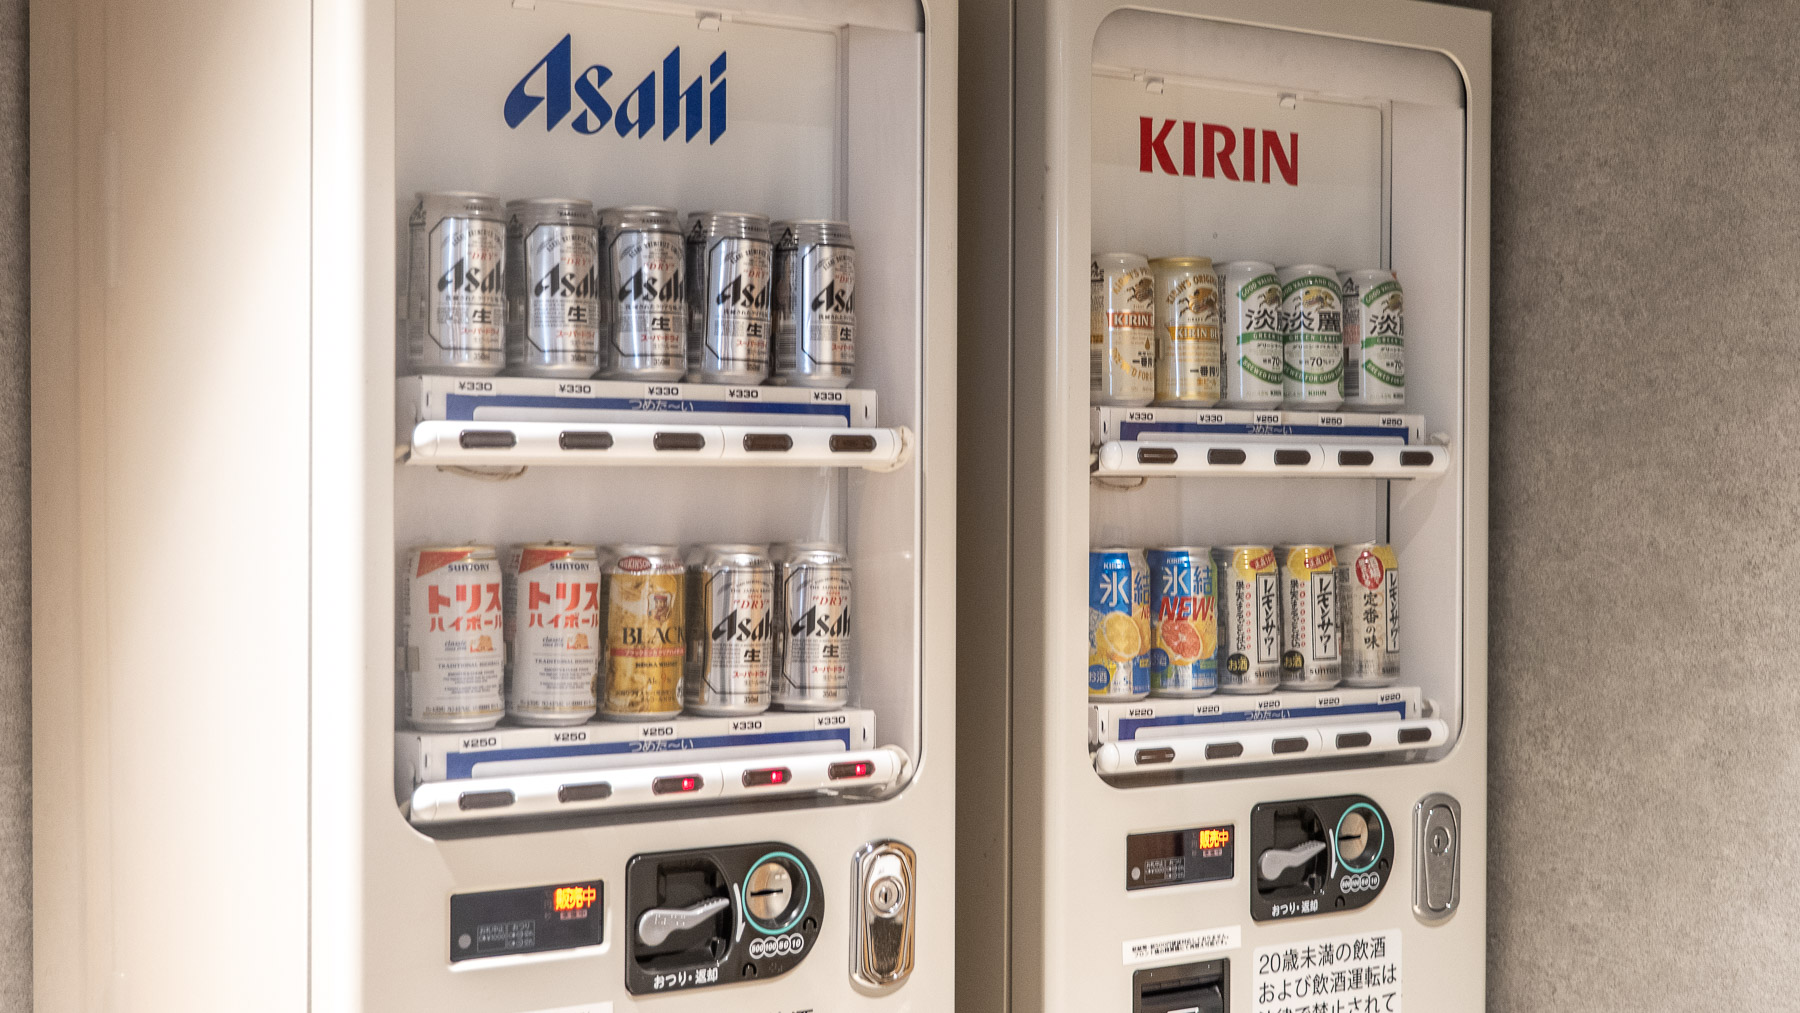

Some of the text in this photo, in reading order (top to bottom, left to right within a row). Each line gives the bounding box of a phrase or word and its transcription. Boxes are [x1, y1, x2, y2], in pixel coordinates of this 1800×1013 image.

[504, 33, 727, 146] Asahi
[1140, 115, 1299, 187] KIRIN
[1314, 279, 1326, 287] AND
[472, 308, 492, 324] 生
[568, 305, 588, 323] 生
[1114, 314, 1150, 327] KIRIN
[652, 317, 671, 331] 生
[747, 323, 763, 338] 生
[1370, 313, 1404, 336] 淡
[840, 327, 852, 341] 生
[1178, 327, 1207, 338] KIRIN
[459, 382, 493, 391] ¥330
[559, 385, 591, 394] ¥330
[647, 387, 679, 396] ¥330
[728, 389, 759, 399] ¥330
[813, 392, 842, 401] ¥330
[1129, 412, 1154, 421] ¥330
[1199, 414, 1223, 422] ¥330
[1256, 415, 1279, 423] ¥250
[1320, 417, 1342, 425] ¥250
[1381, 418, 1402, 426] ¥250
[448, 562, 490, 573] SUNTORY
[549, 562, 590, 572] SUNTORY
[1163, 565, 1213, 597] 氷結
[528, 581, 599, 611] トリス
[1100, 571, 1150, 607] 氷結
[428, 582, 502, 615] トリス
[1158, 596, 1216, 621] NEW!
[1389, 571, 1400, 650] レモンサワー
[429, 614, 503, 632] ハイボール
[529, 611, 599, 629] ハイボール
[1261, 578, 1277, 657] レモンサワー
[1316, 577, 1334, 655] レモンサワー
[1363, 590, 1380, 650] 定番の味
[744, 648, 761, 662] 生
[823, 644, 839, 658] 生
[1228, 656, 1248, 673] お酒
[1284, 653, 1302, 670] お酒
[1258, 699, 1280, 709] ¥220
[1318, 697, 1340, 706] ¥220
[1380, 693, 1401, 702] ¥220
[1129, 708, 1154, 717] ¥220
[1197, 705, 1220, 714] ¥220
[732, 721, 762, 731] ¥330
[817, 715, 846, 725] ¥330
[553, 731, 587, 742] ¥250
[642, 727, 674, 737] ¥250
[462, 737, 497, 748] ¥250
[1200, 829, 1229, 850] 販売中
[1271, 899, 1319, 917] おつり・返却
[1259, 936, 1386, 975] 20歳未満の飲酒
[654, 967, 719, 990] おつり・返却
[1258, 963, 1398, 1005] および飲酒運転は
